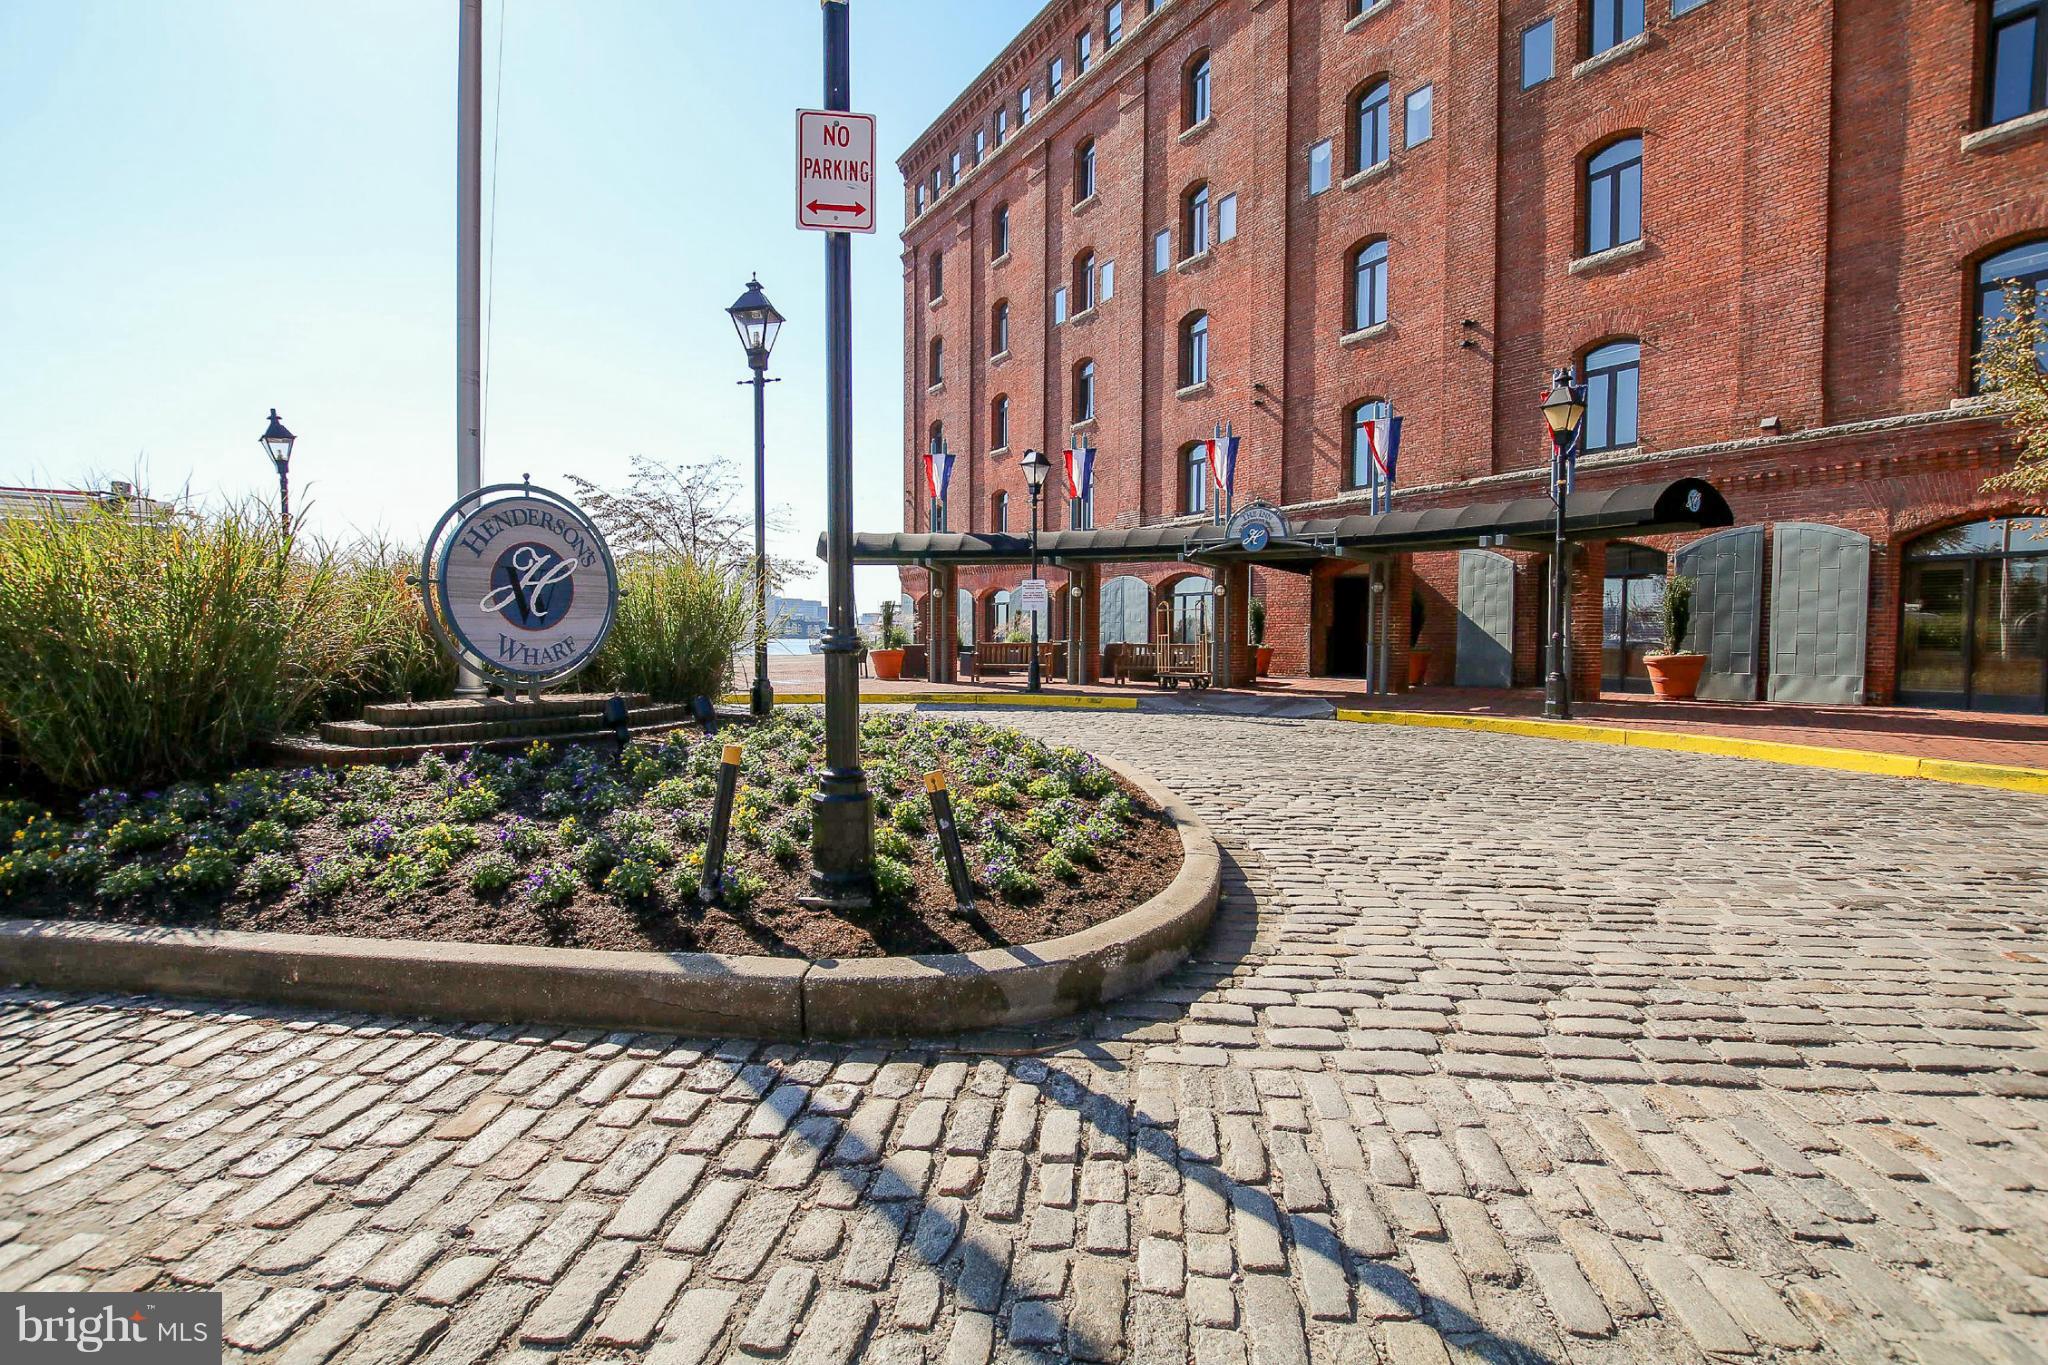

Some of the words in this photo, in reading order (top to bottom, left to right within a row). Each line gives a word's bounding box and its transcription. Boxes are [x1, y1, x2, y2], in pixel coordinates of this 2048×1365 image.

[823, 125, 850, 147] NO
[803, 157, 869, 182] PARKING
[461, 508, 596, 568] HENDERSON'S
[498, 633, 577, 665] WHARF
